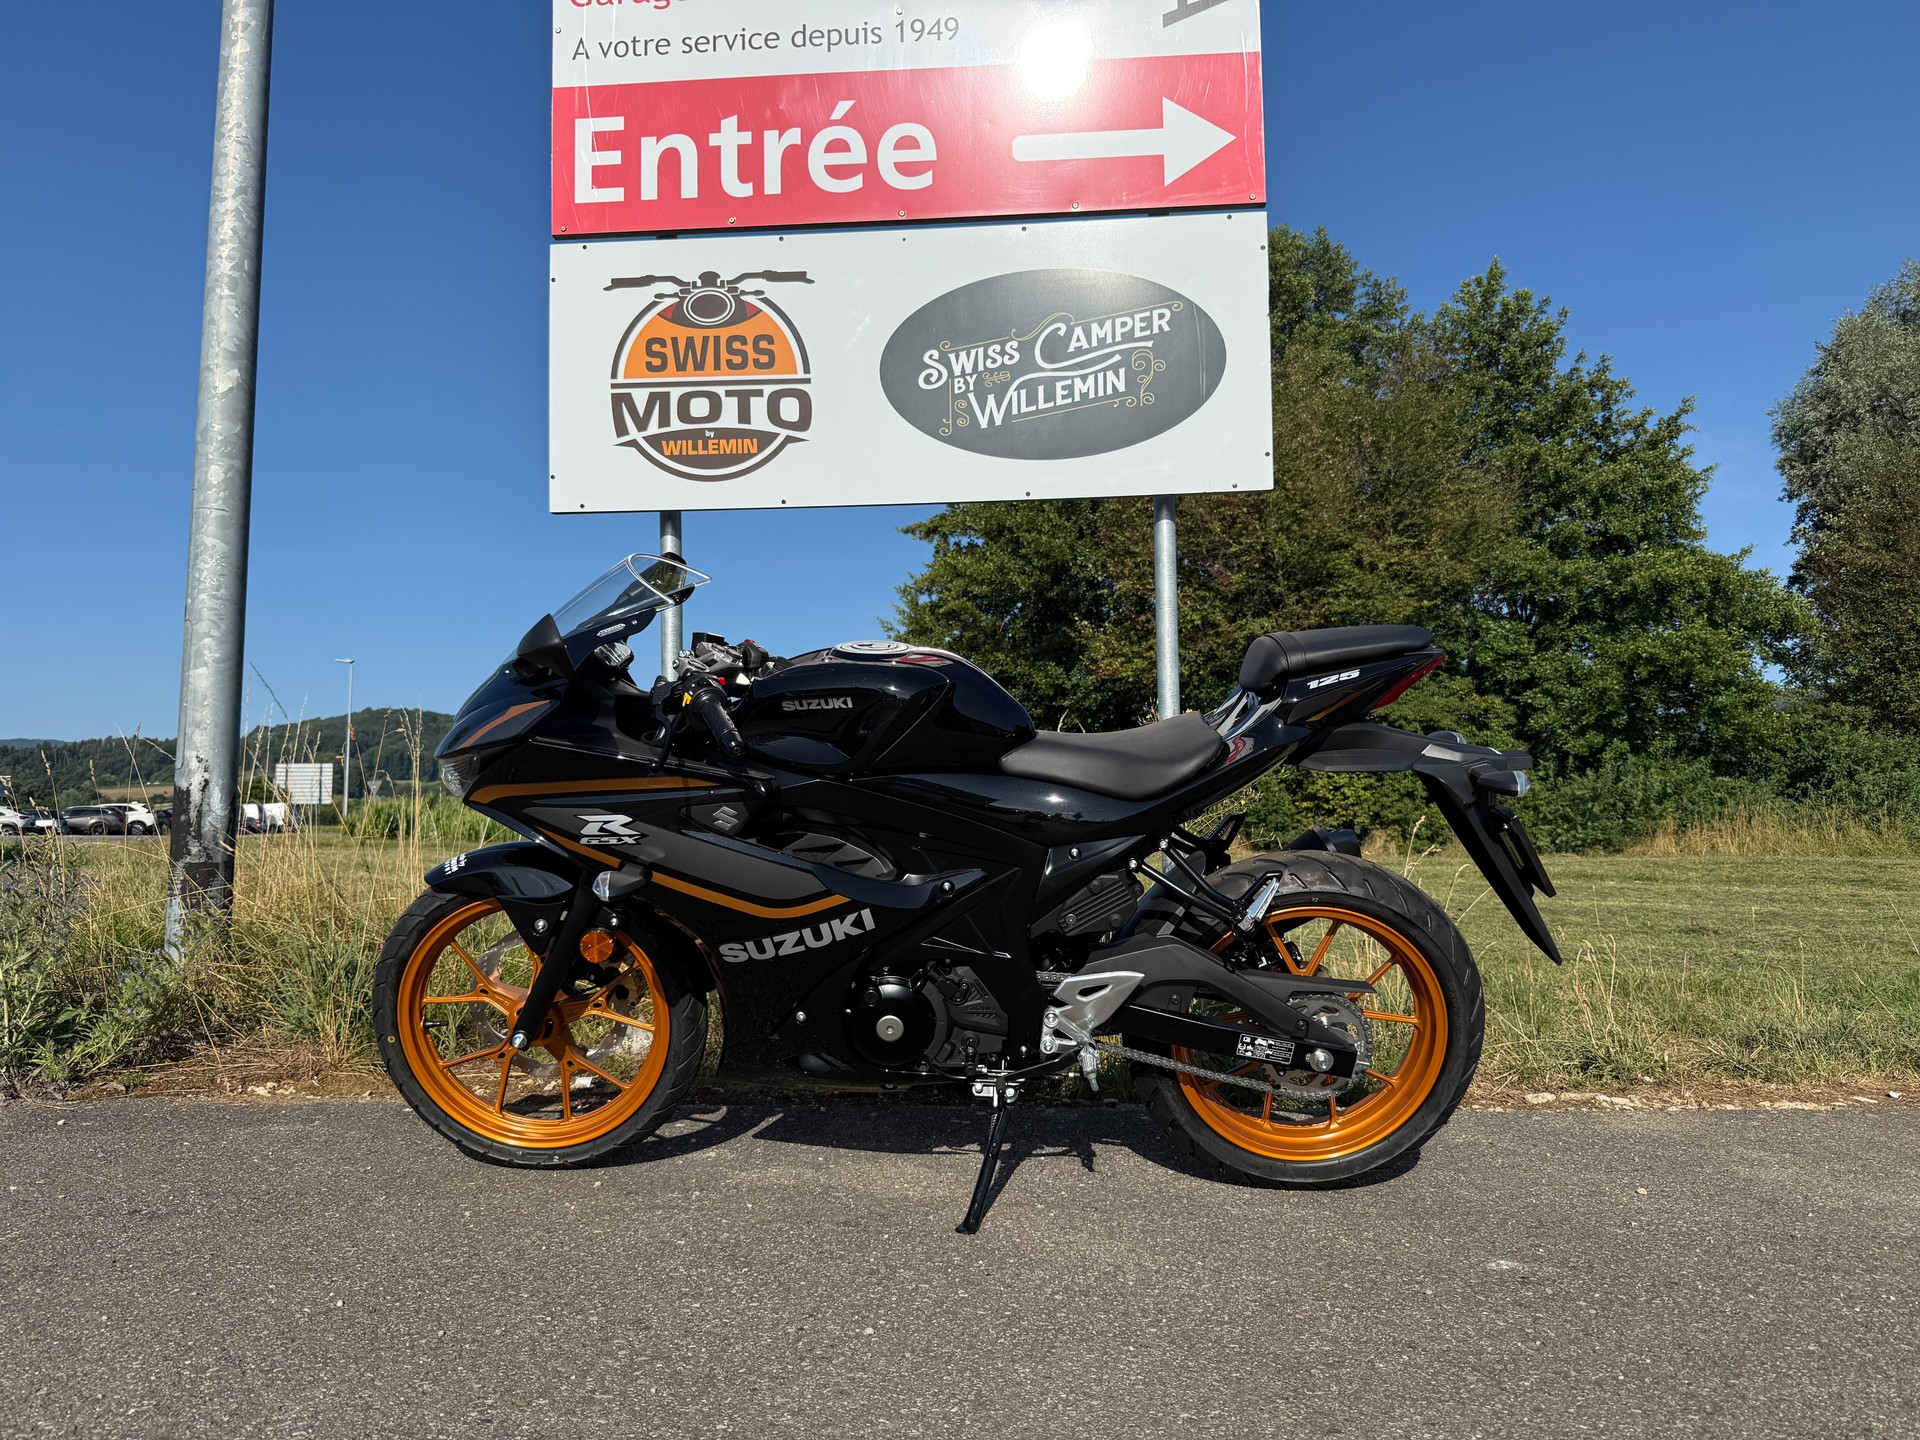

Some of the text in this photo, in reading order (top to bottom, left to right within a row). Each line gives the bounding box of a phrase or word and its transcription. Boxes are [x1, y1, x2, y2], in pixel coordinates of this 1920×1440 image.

[571, 16, 960, 61] A votre service depuis 1949
[573, 100, 938, 204] Entrée
[644, 333, 777, 373] SWISS
[917, 307, 1172, 390] SWISS CAMPER
[953, 374, 979, 394] BY
[967, 354, 1127, 430] WILLEMIN
[610, 387, 813, 439] MOTO
[705, 429, 715, 438] by
[661, 438, 758, 456] WILLEMIN
[1306, 668, 1361, 690] 125
[781, 696, 853, 712] SUZUKI
[718, 907, 876, 963] SUZUKI
